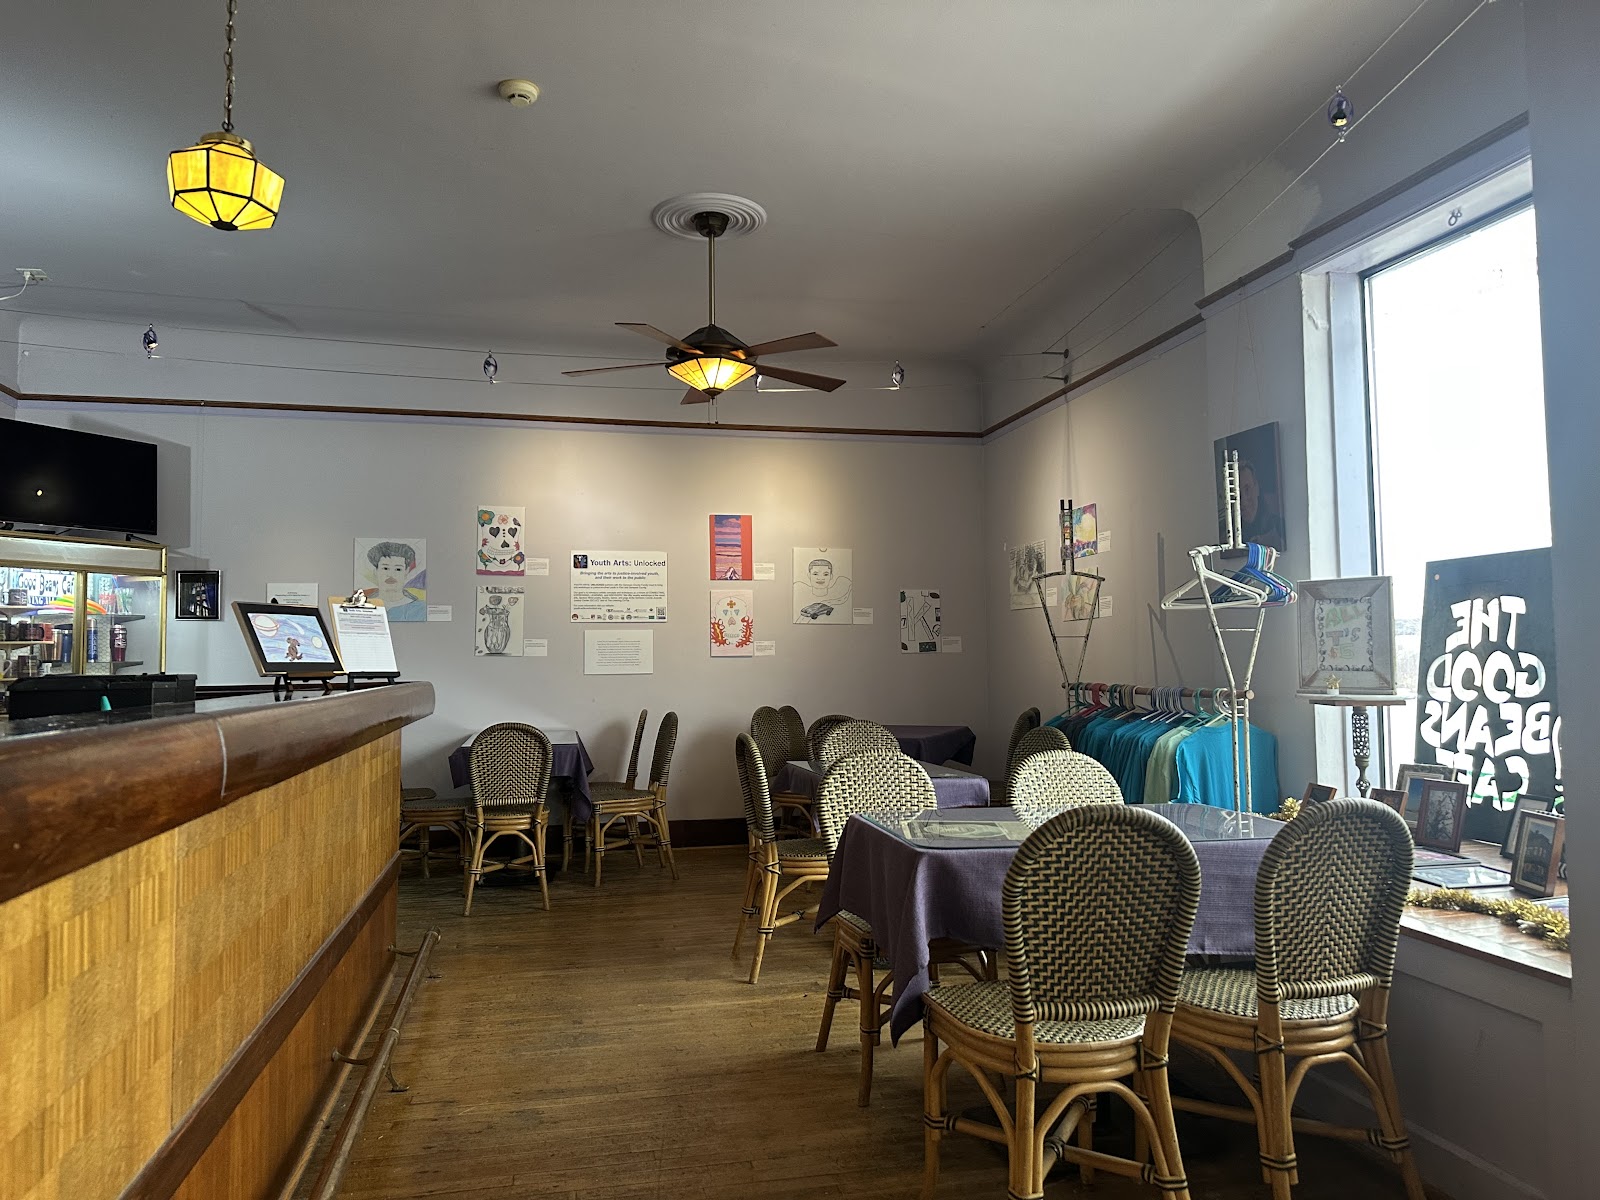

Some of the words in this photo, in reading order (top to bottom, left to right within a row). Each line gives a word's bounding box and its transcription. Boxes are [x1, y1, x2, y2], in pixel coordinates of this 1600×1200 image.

[590, 559, 611, 567] Youth
[613, 559, 632, 567] Arts:
[633, 559, 666, 567] Unlocked
[18, 573, 36, 590] Good
[1325, 604, 1367, 628] ALL
[1326, 627, 1361, 647] T'S
[1328, 642, 1355, 660] $5
